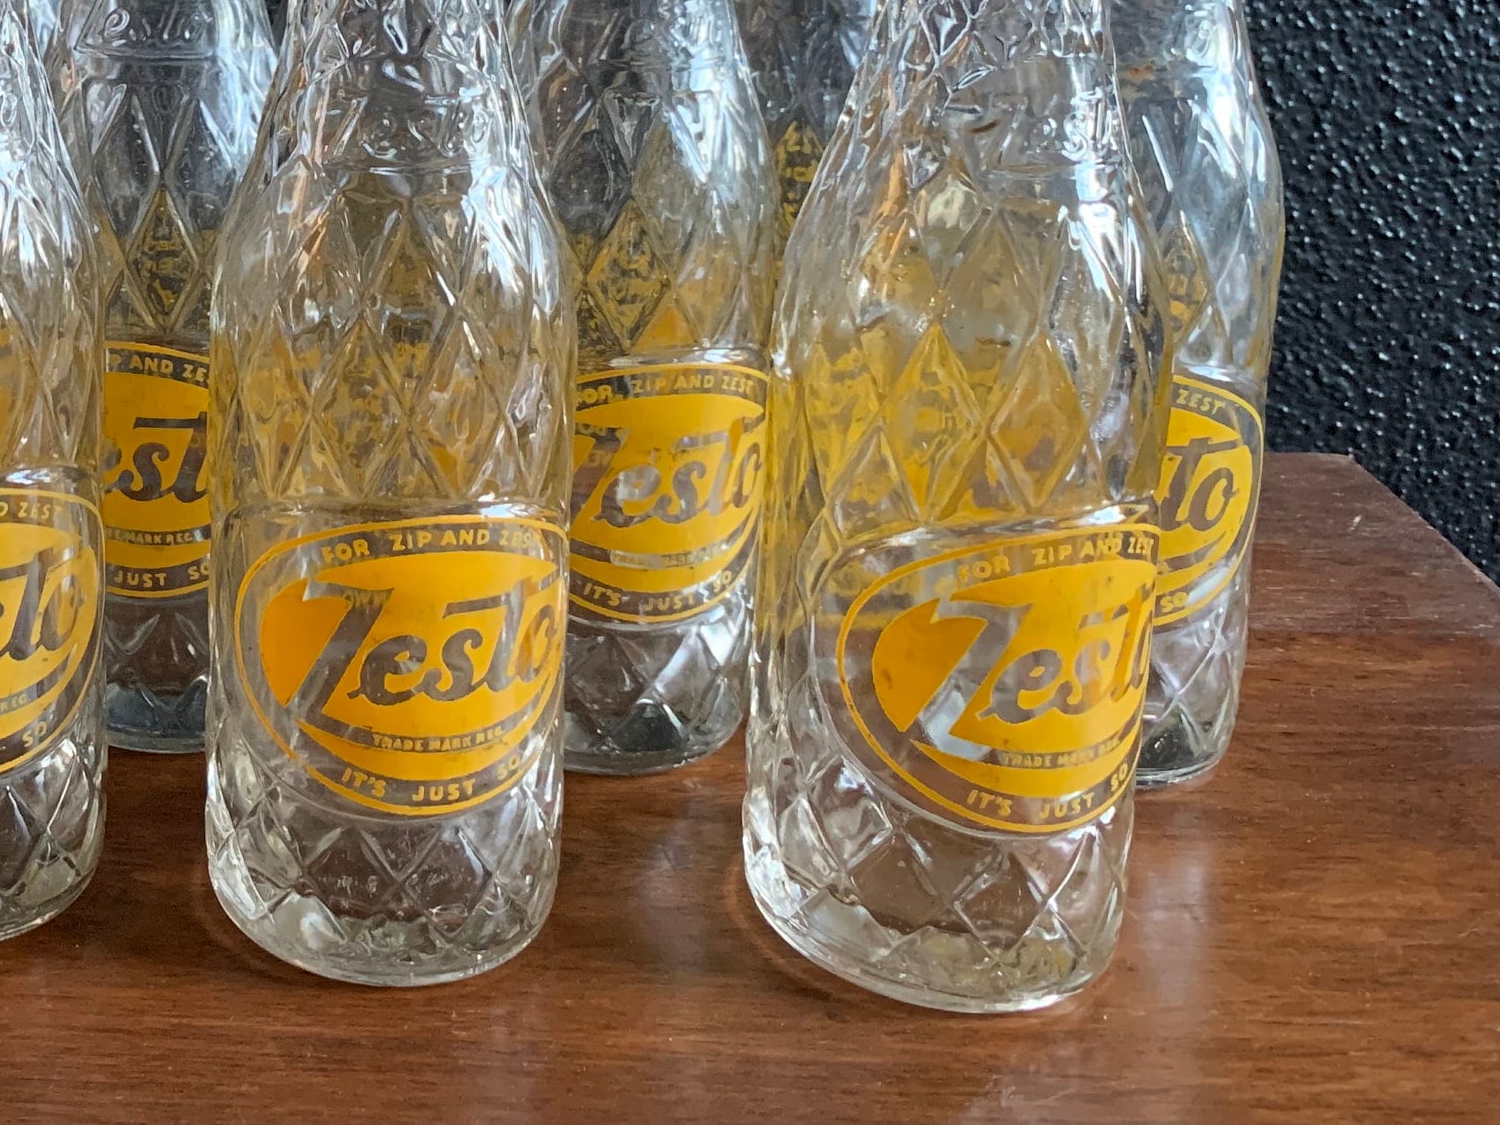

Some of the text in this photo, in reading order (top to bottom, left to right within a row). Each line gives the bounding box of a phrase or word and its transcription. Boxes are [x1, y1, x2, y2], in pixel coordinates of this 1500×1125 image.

[129, 355, 174, 374] AND
[1176, 389, 1225, 416] ZEST
[321, 538, 371, 565] FOR
[392, 533, 432, 552] ZIP
[441, 529, 491, 547] AND
[956, 555, 1011, 583] FOR
[1031, 544, 1073, 566] ZIP
[113, 569, 167, 589] JUST
[582, 583, 622, 607] IT'S
[643, 592, 694, 612] JUST
[1161, 591, 1189, 613] SO
[293, 576, 557, 717] Zesto
[22, 721, 48, 748] SO
[372, 733, 424, 752] TRADE
[342, 754, 521, 802] IT'S JUST SO
[966, 762, 1129, 820] IT'S JUST SO
